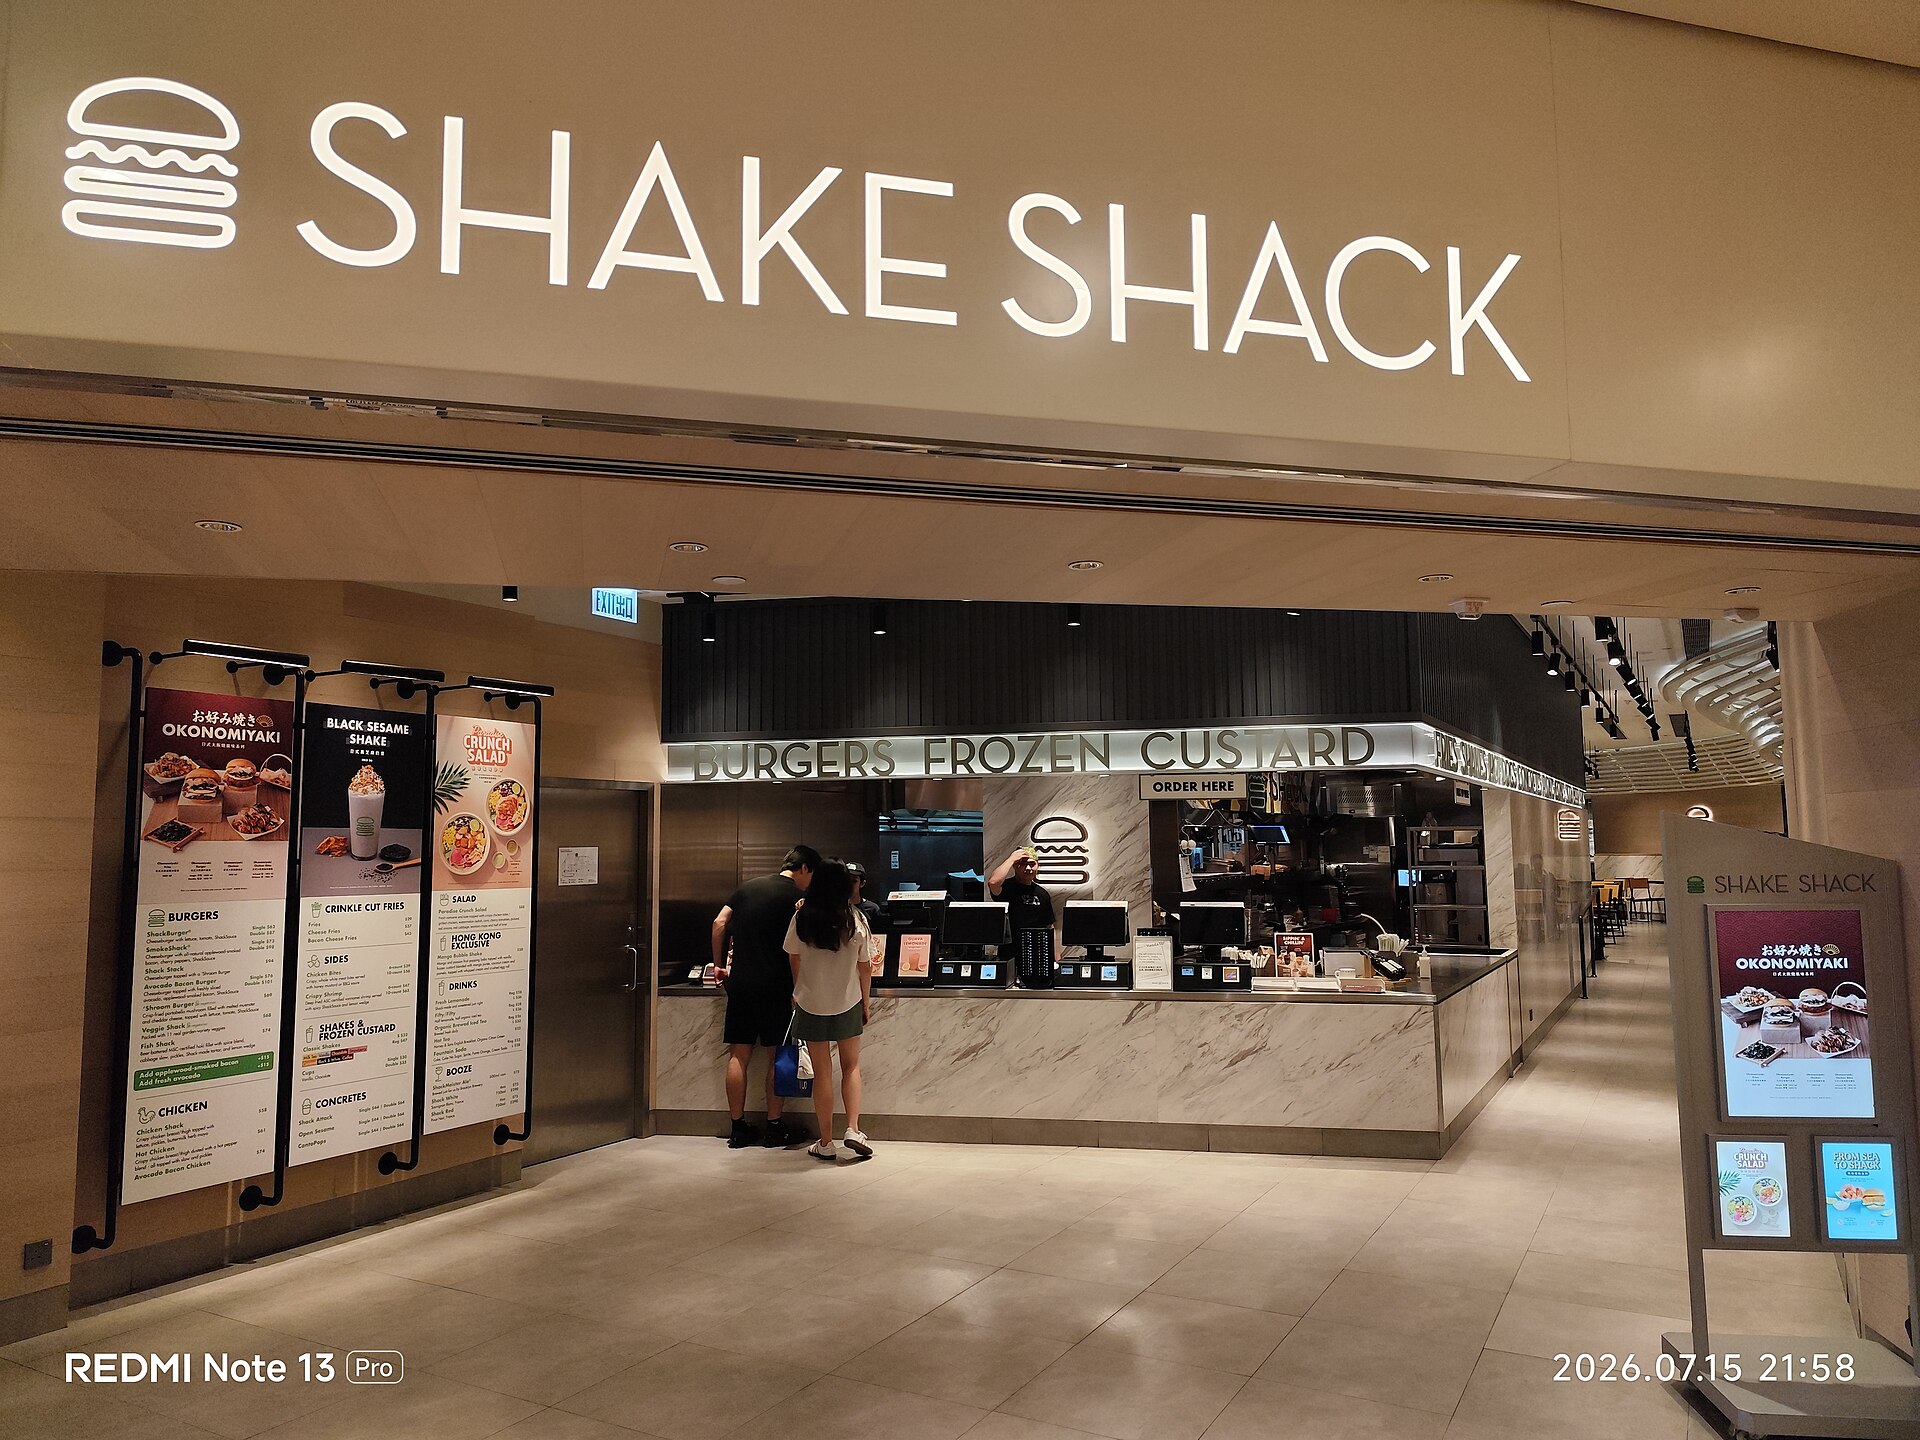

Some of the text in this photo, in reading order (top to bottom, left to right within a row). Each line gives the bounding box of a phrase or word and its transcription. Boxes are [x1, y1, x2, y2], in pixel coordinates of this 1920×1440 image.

[296, 101, 1531, 383] SHAKE SHACK
[596, 589, 633, 620] EXIT 出口
[192, 709, 256, 728] お好み焼き
[327, 717, 410, 735] BLACK SESAME
[162, 723, 281, 744] OKONOMIYAKI
[349, 734, 387, 746] SHAKE
[463, 735, 512, 753] CRUNCH
[467, 749, 508, 766] SALAD
[693, 726, 1375, 782] BURGERS FROZEN CUSTARD
[1153, 781, 1234, 792] ORDER HERE
[1714, 873, 1876, 894] SHAKE SHACK
[453, 895, 476, 903] SALAD
[325, 902, 404, 913] CRINKLE CUT FRIES
[168, 911, 219, 922] BURGERS
[452, 932, 501, 942] HONG KONG
[452, 940, 490, 950] EXCLUSIVE
[1762, 944, 1822, 957] お好み焼き
[324, 955, 349, 964] SIDES
[1735, 958, 1848, 970] OKONOMIYAKI
[449, 980, 477, 990] DRINKS
[173, 1001, 194, 1009] Burger
[142, 1026, 164, 1034] Veggie
[319, 1020, 364, 1033] SHAKES &
[319, 1024, 396, 1041] FROZEN CUSTARD
[155, 1062, 219, 1078] applewood-smoked
[302, 1069, 314, 1077] Cups
[446, 1065, 472, 1076] BOOZE
[174, 1072, 201, 1081] avocado
[433, 1081, 461, 1090] ShackMeister
[316, 1092, 367, 1109] CONCRETES
[158, 1100, 208, 1117] CHICKEN
[137, 1122, 184, 1136] Chicken Shack
[299, 1126, 335, 1138] Open Sesame
[150, 1145, 175, 1155] Chicken
[298, 1139, 326, 1150] CantoPops
[1734, 1152, 1768, 1162] CRUNCH
[1834, 1152, 1881, 1162] FROM SEA
[1737, 1160, 1766, 1169] SALAD
[1834, 1161, 1881, 1170] TO SHACK
[134, 1160, 211, 1181] Avocado Bacon Chicken
